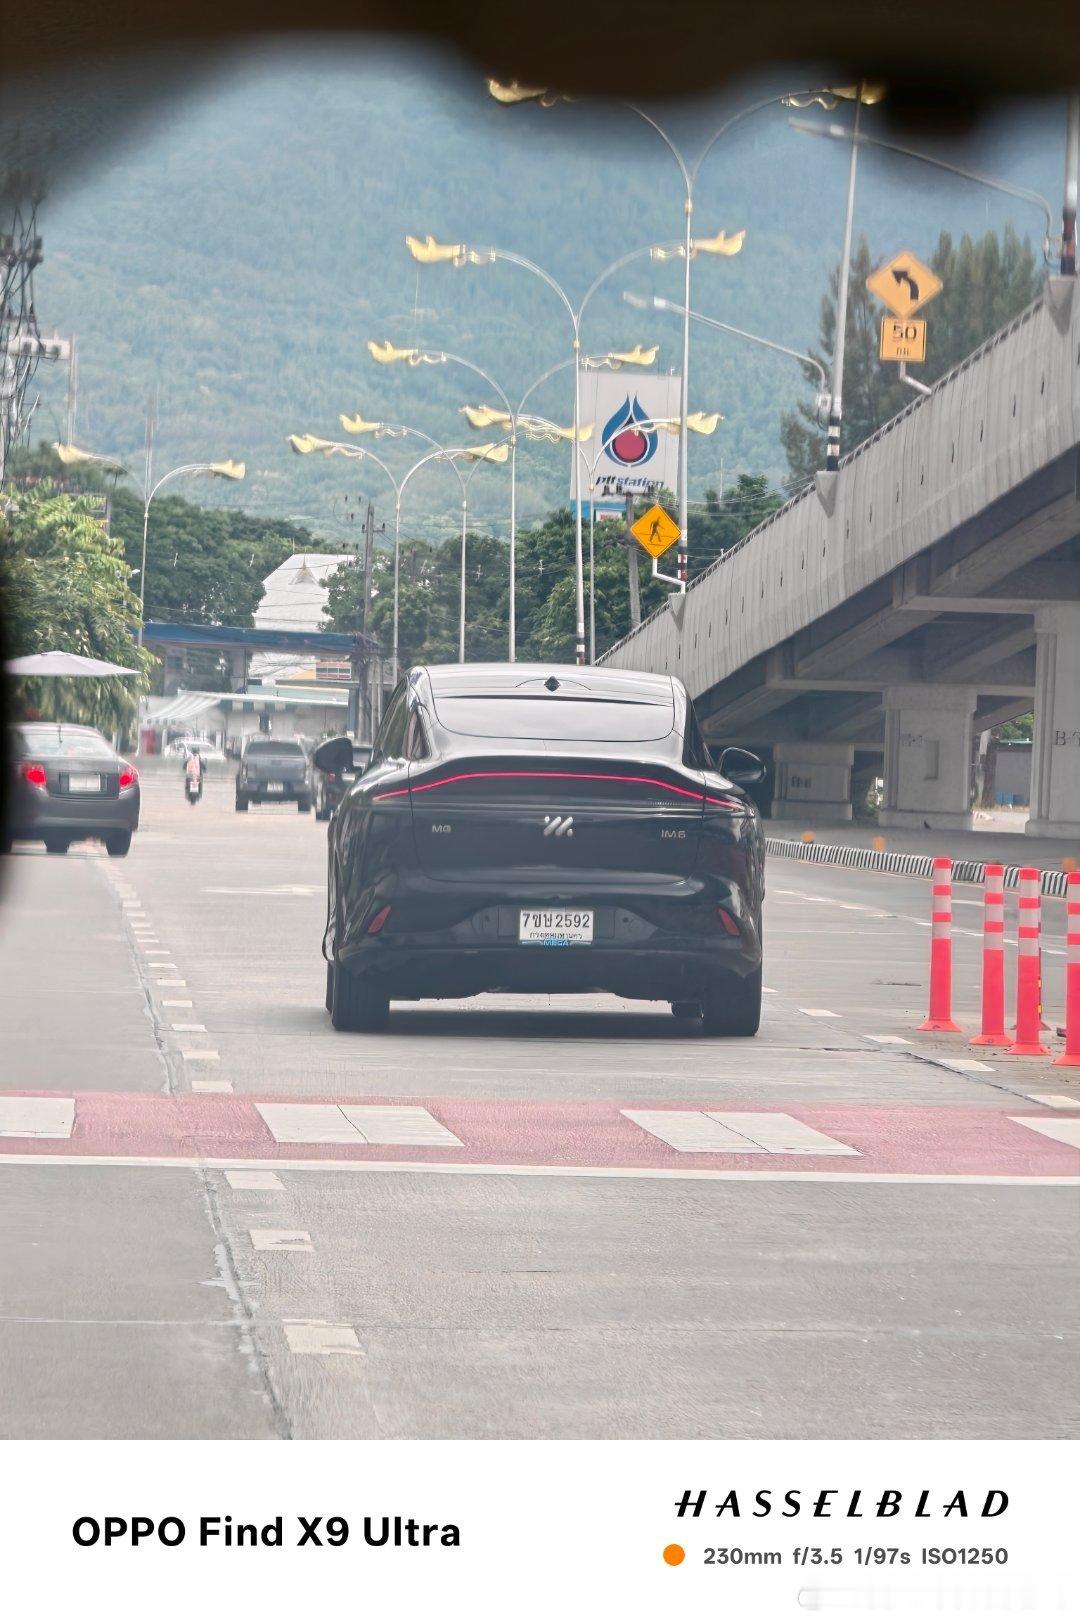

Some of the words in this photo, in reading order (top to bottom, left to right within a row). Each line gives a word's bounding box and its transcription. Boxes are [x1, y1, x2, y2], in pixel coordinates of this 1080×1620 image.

[893, 324, 917, 340] 50
[617, 476, 665, 488] station
[432, 824, 452, 833] MG
[555, 914, 590, 928] 2592
